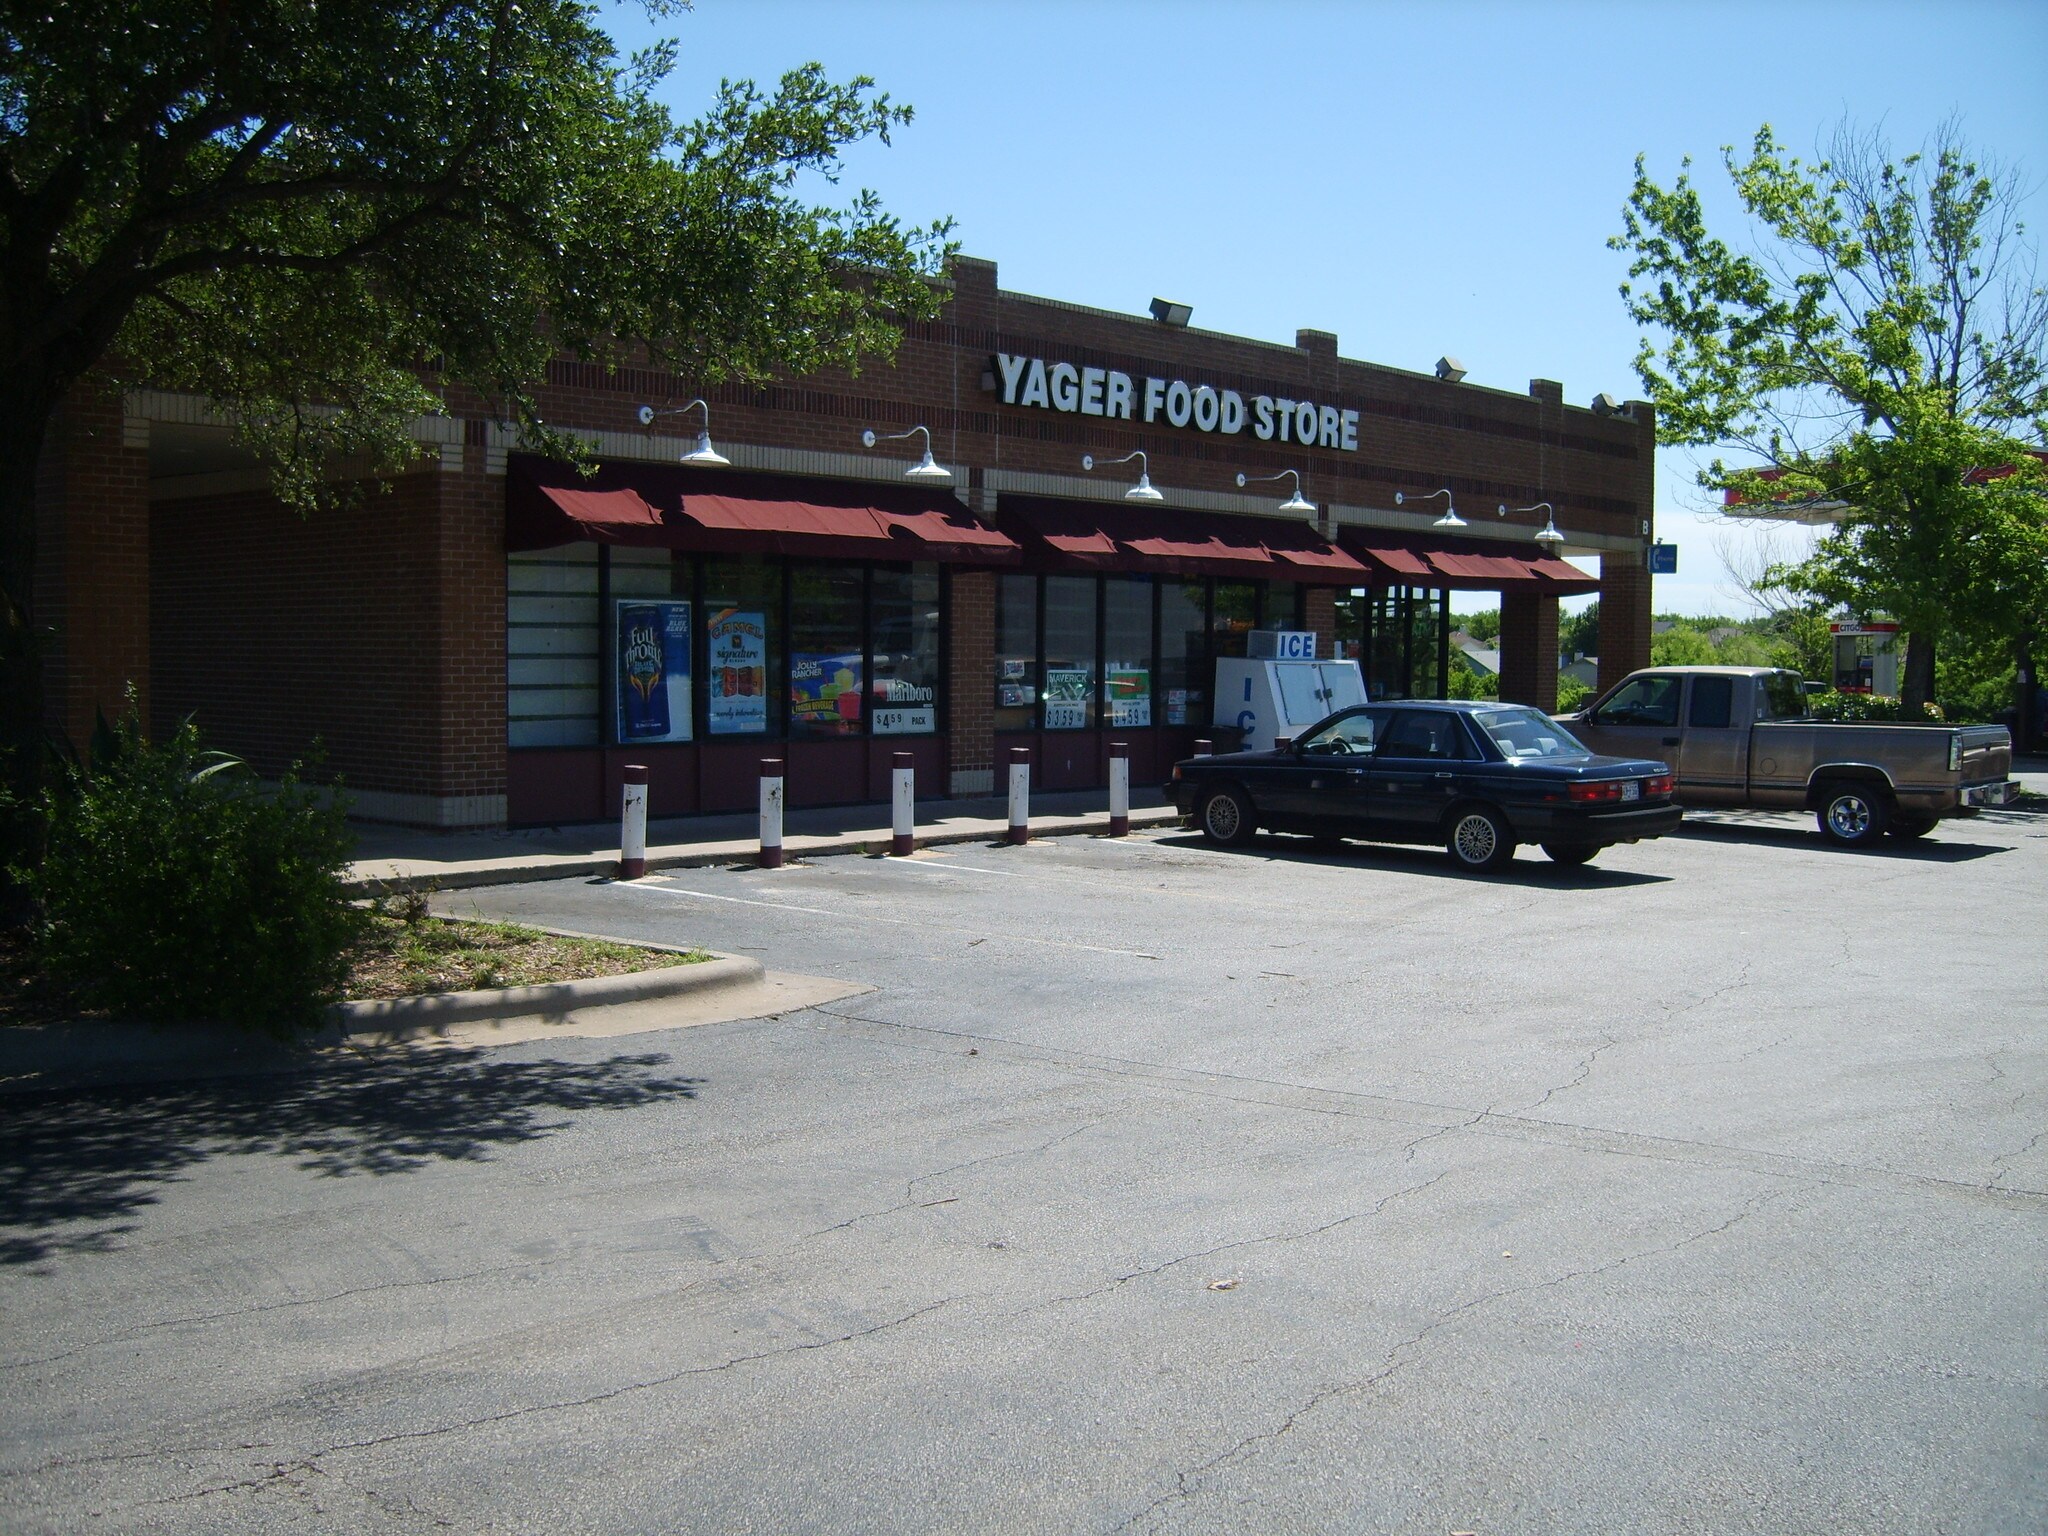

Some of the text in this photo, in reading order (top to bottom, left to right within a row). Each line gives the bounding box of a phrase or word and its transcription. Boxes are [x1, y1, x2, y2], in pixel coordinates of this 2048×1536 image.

[995, 352, 1360, 452] YAGER FOOD STORE
[1642, 519, 1649, 535] B
[711, 621, 764, 640] CAMEL
[1839, 623, 1861, 632] CITGO
[1279, 634, 1313, 658] ICE
[717, 646, 759, 665] signature
[796, 660, 817, 671] JOLLY
[791, 668, 822, 680] RANCHER
[1049, 673, 1087, 683] MAVERICK
[886, 681, 933, 702] Marlboro
[911, 716, 926, 726] PACK
